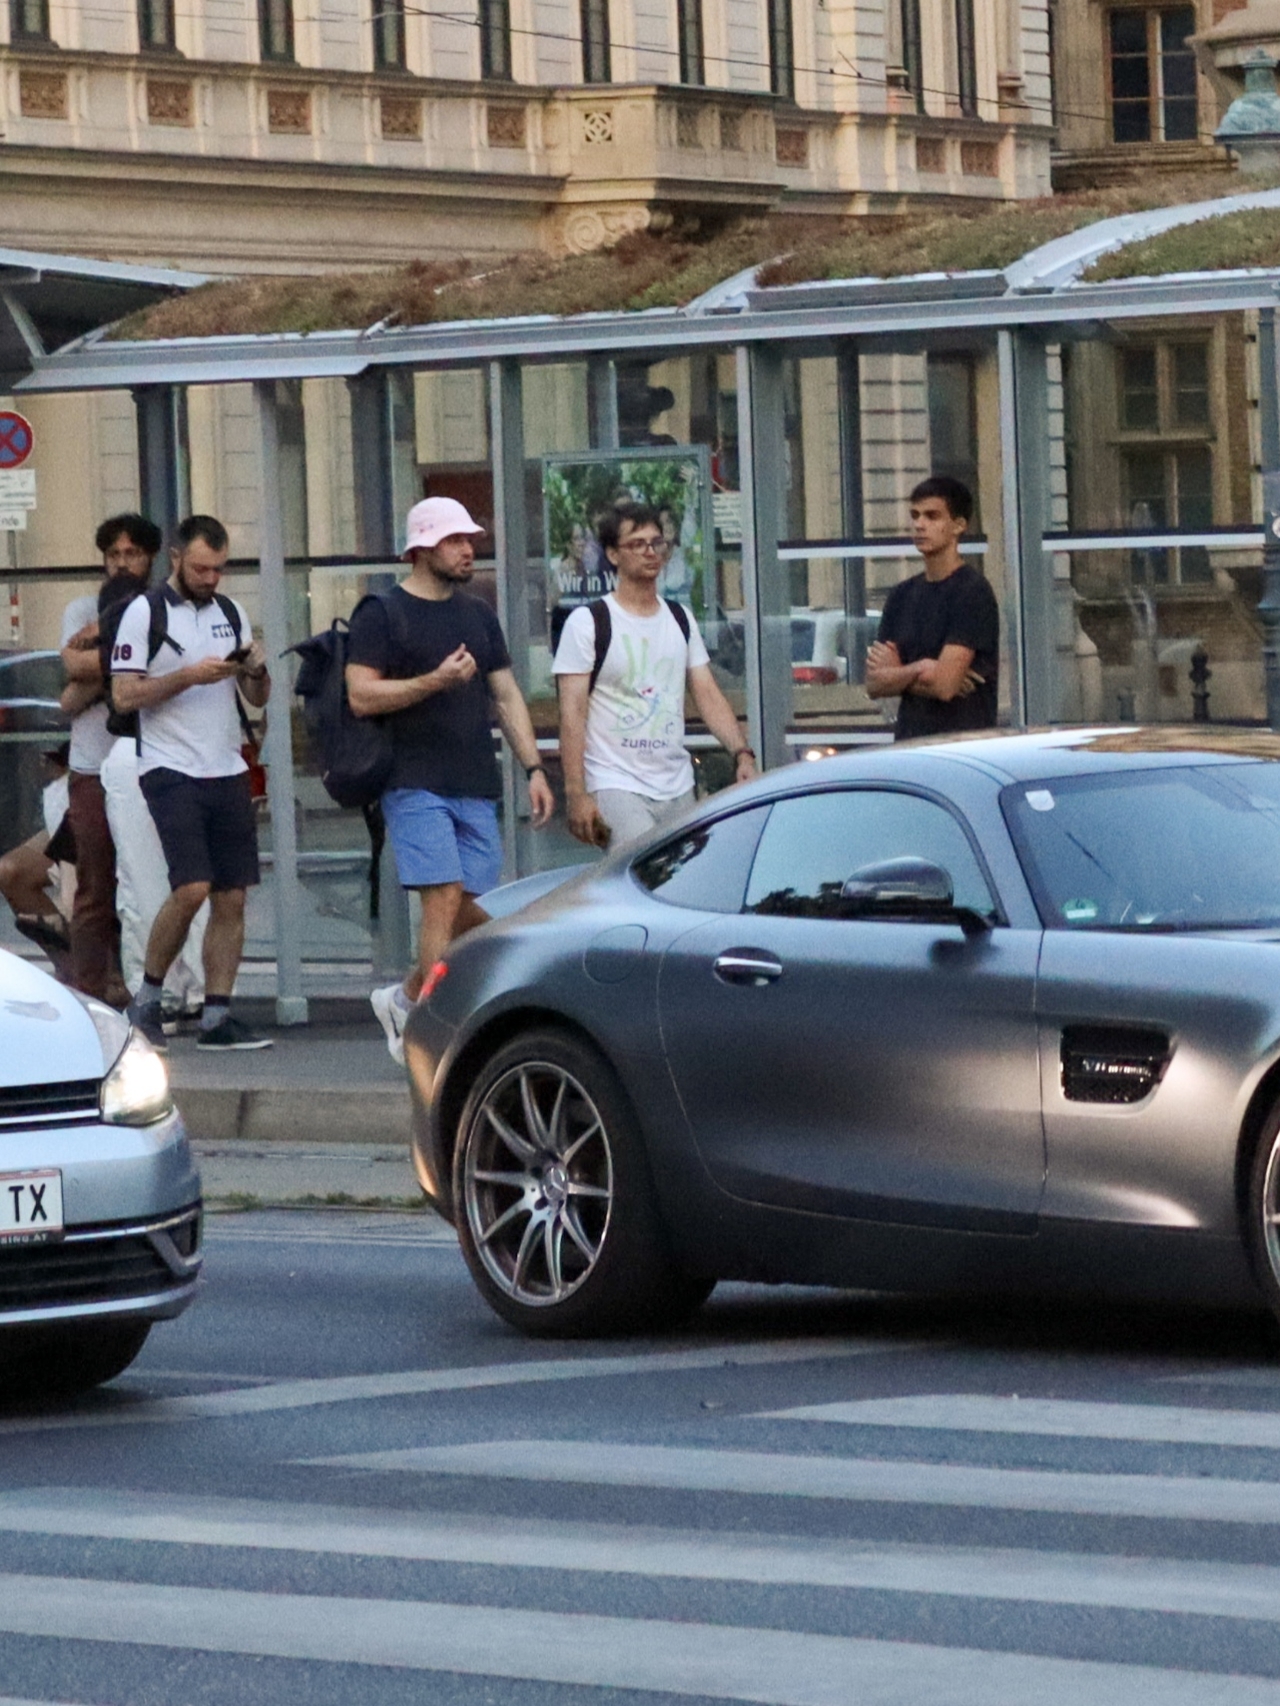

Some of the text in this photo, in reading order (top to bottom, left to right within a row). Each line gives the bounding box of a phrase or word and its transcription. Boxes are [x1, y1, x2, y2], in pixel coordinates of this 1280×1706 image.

[558, 570, 583, 593] Wir
[586, 569, 602, 592] in
[621, 737, 668, 749] ZURICH
[8, 1183, 47, 1223] TX
